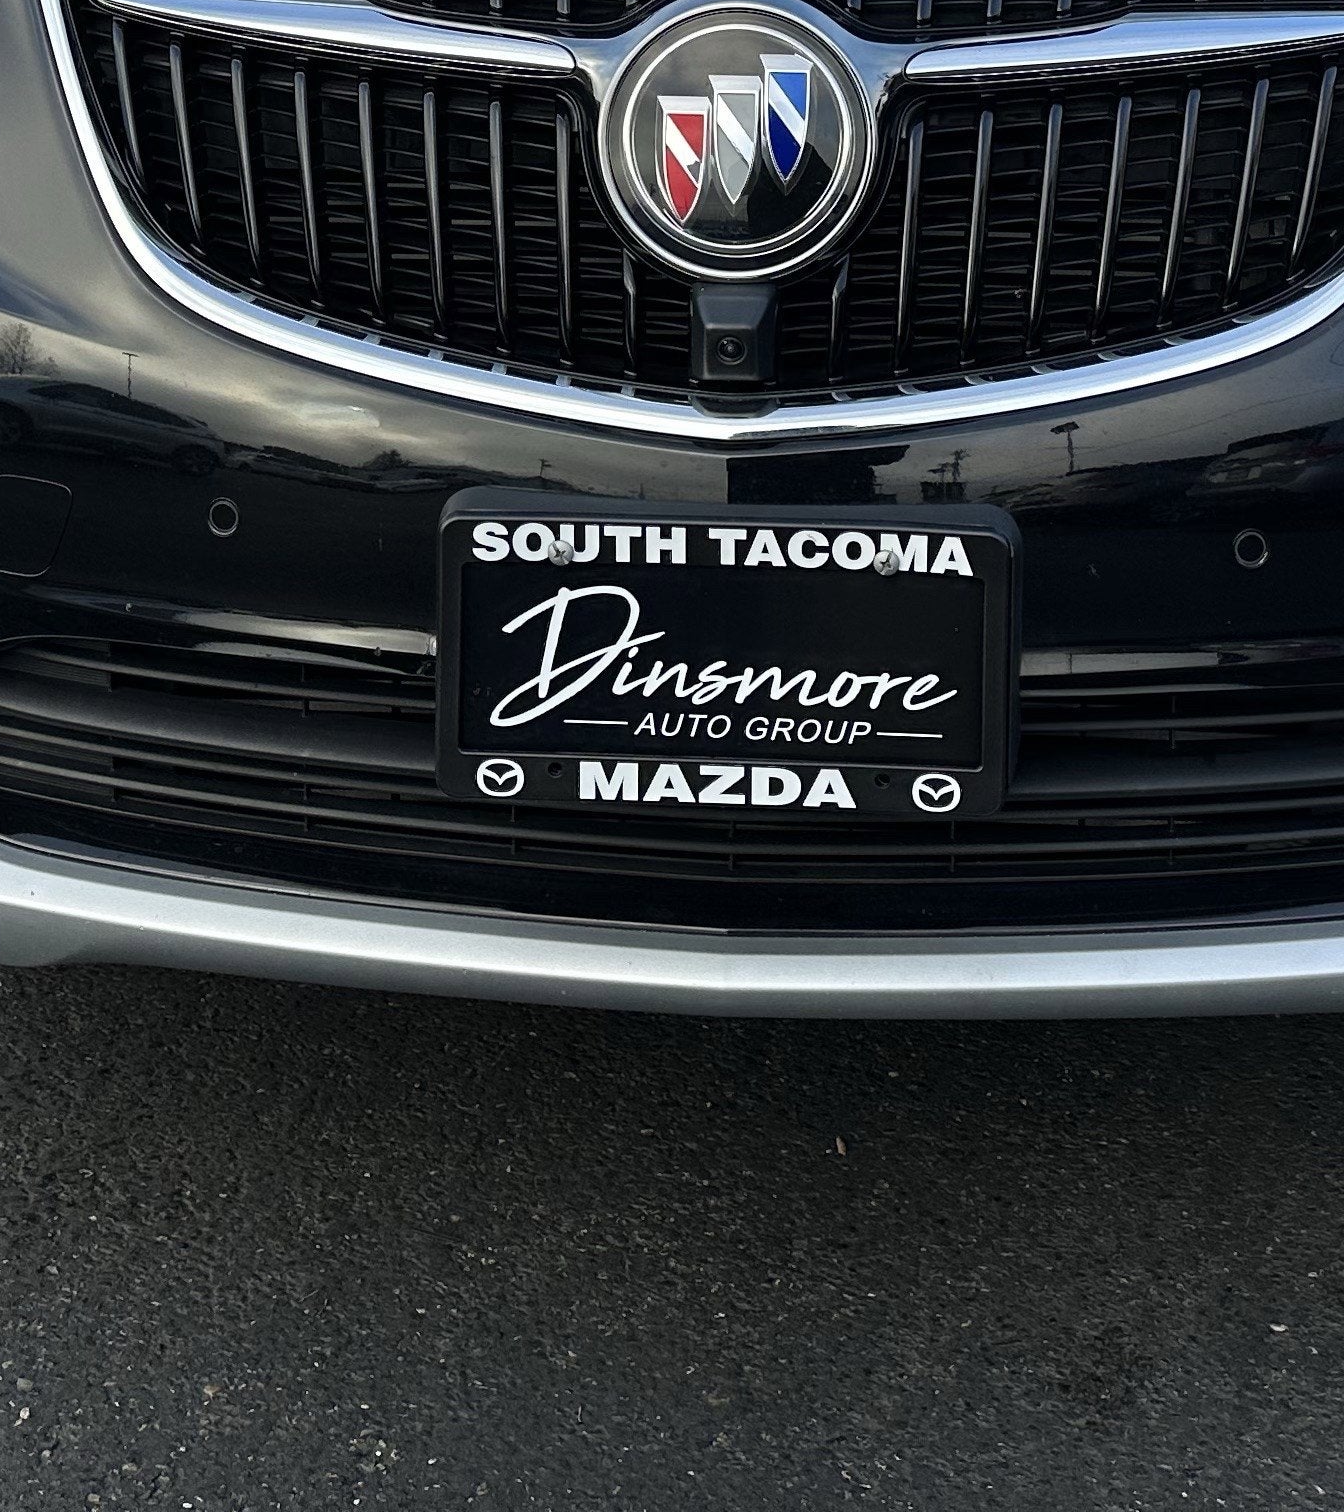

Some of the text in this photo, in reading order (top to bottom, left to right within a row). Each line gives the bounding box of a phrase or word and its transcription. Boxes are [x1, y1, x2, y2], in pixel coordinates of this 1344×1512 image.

[472, 522, 974, 577] SOUTH TACOMA
[490, 586, 958, 728] Dinsmore
[634, 713, 872, 745] AUTO GROUP
[579, 761, 857, 809] MAZDA
